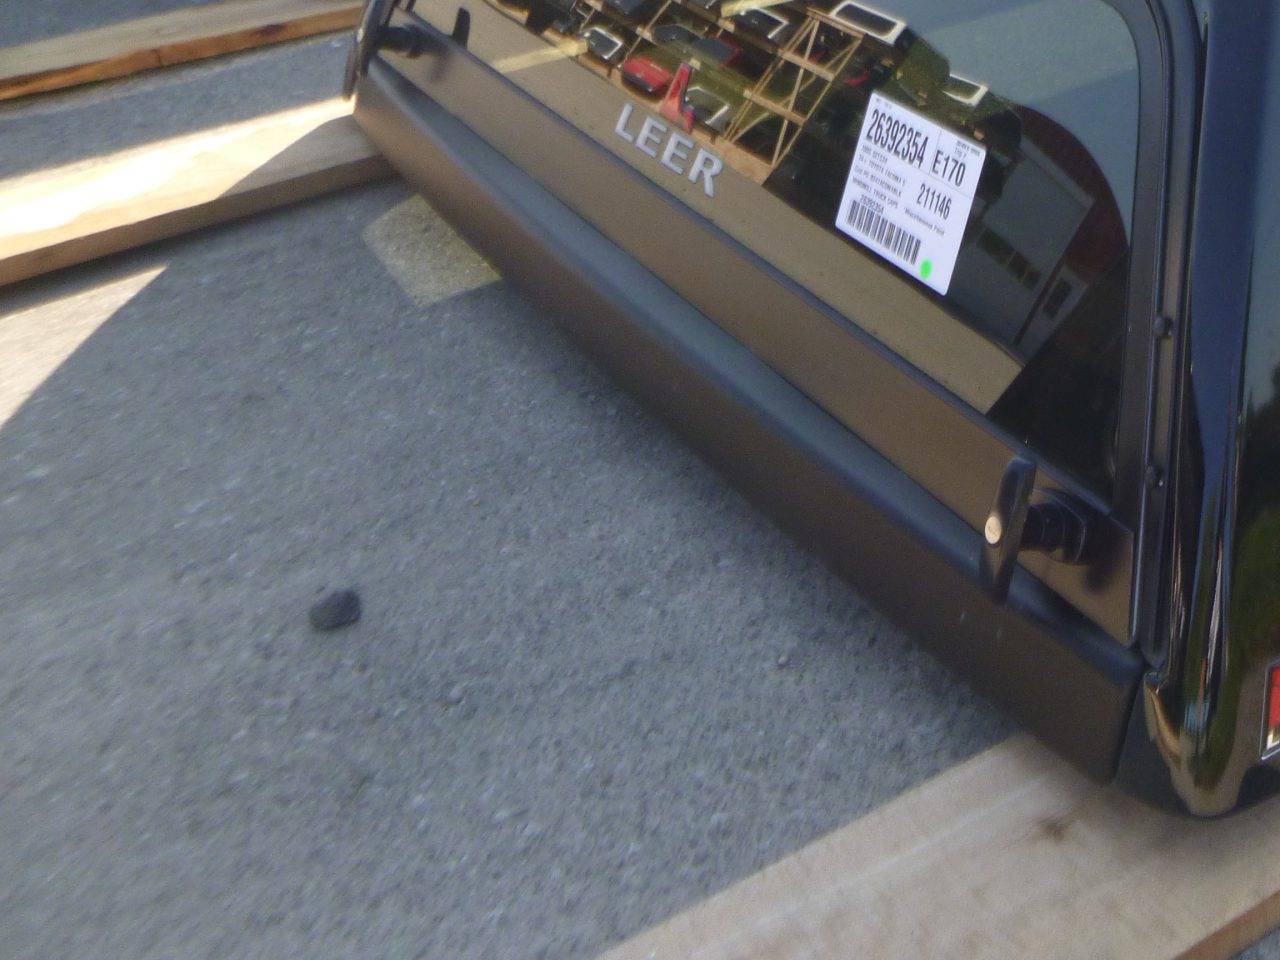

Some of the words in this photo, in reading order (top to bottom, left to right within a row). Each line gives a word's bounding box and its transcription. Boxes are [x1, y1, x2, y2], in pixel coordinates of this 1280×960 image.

[615, 103, 724, 198] LEER
[866, 108, 929, 170] 26392354
[932, 150, 966, 187] E170
[917, 183, 953, 221] 211146
